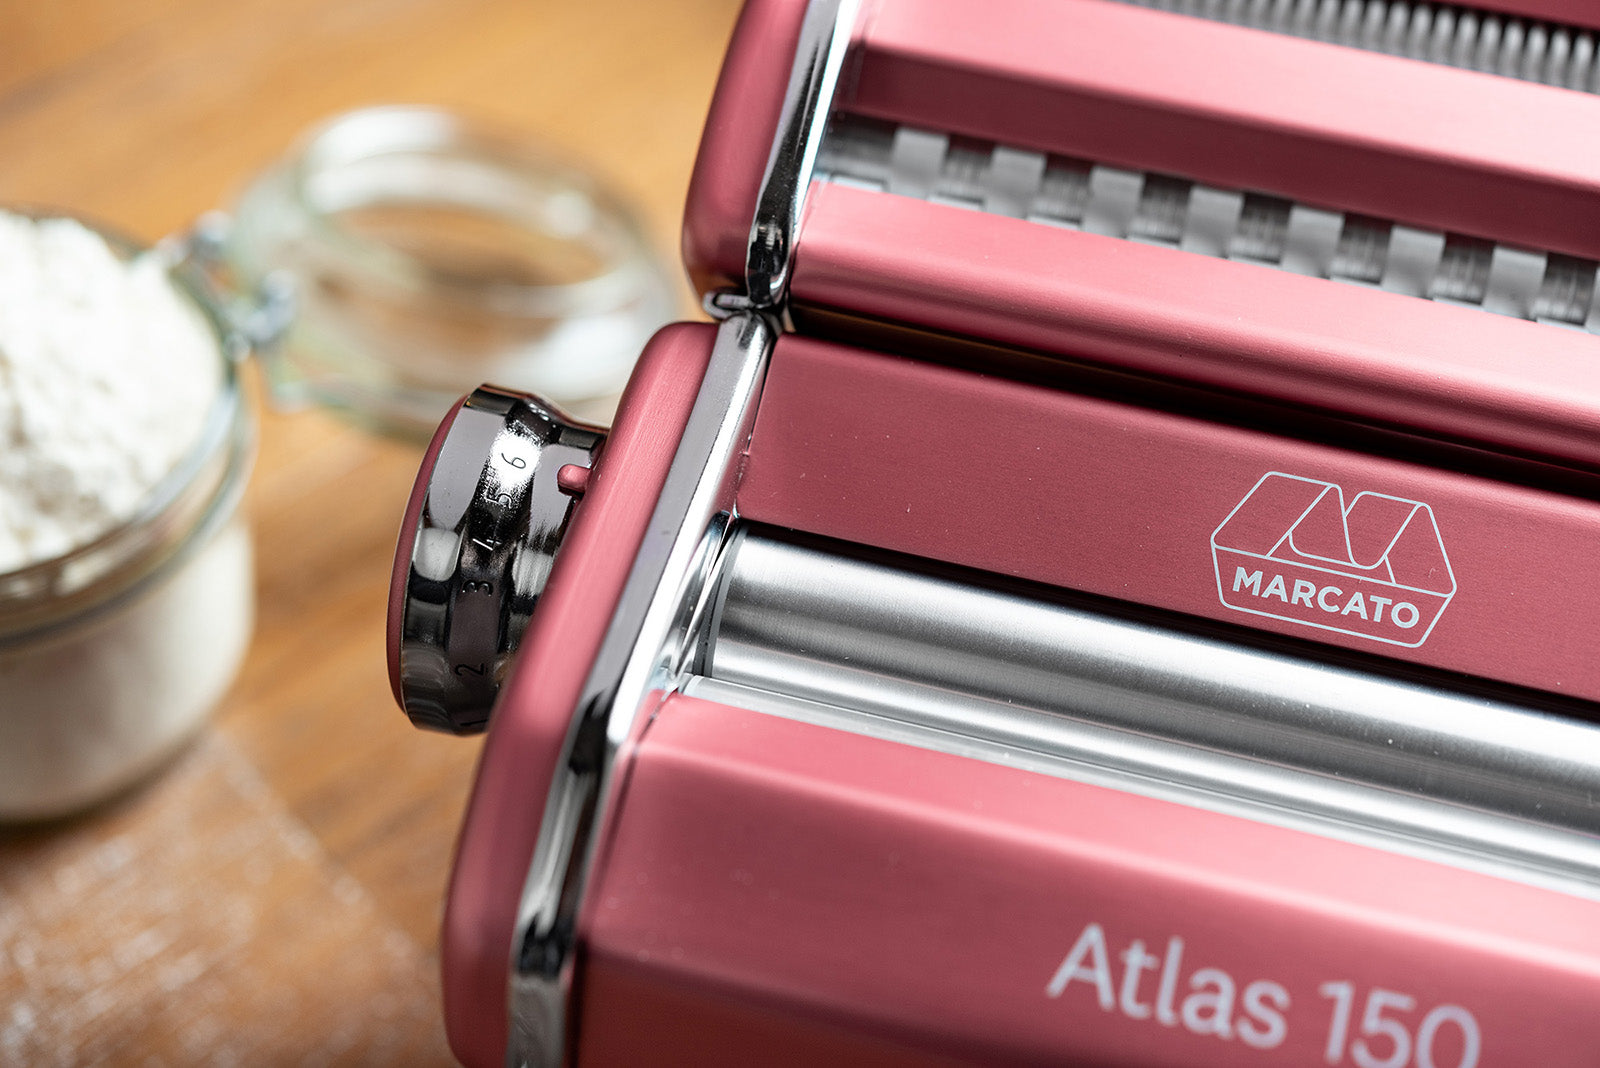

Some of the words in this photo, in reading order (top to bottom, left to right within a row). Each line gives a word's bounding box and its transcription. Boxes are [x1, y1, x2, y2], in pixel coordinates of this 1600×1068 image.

[501, 452, 526, 469] 6
[484, 491, 512, 509] 5
[472, 534, 502, 551] 4
[462, 580, 494, 597] 3
[1232, 566, 1420, 628] MARCATO
[454, 662, 485, 676] 2
[1045, 922, 1291, 1050] Atlas
[1318, 979, 1482, 1068] 150
